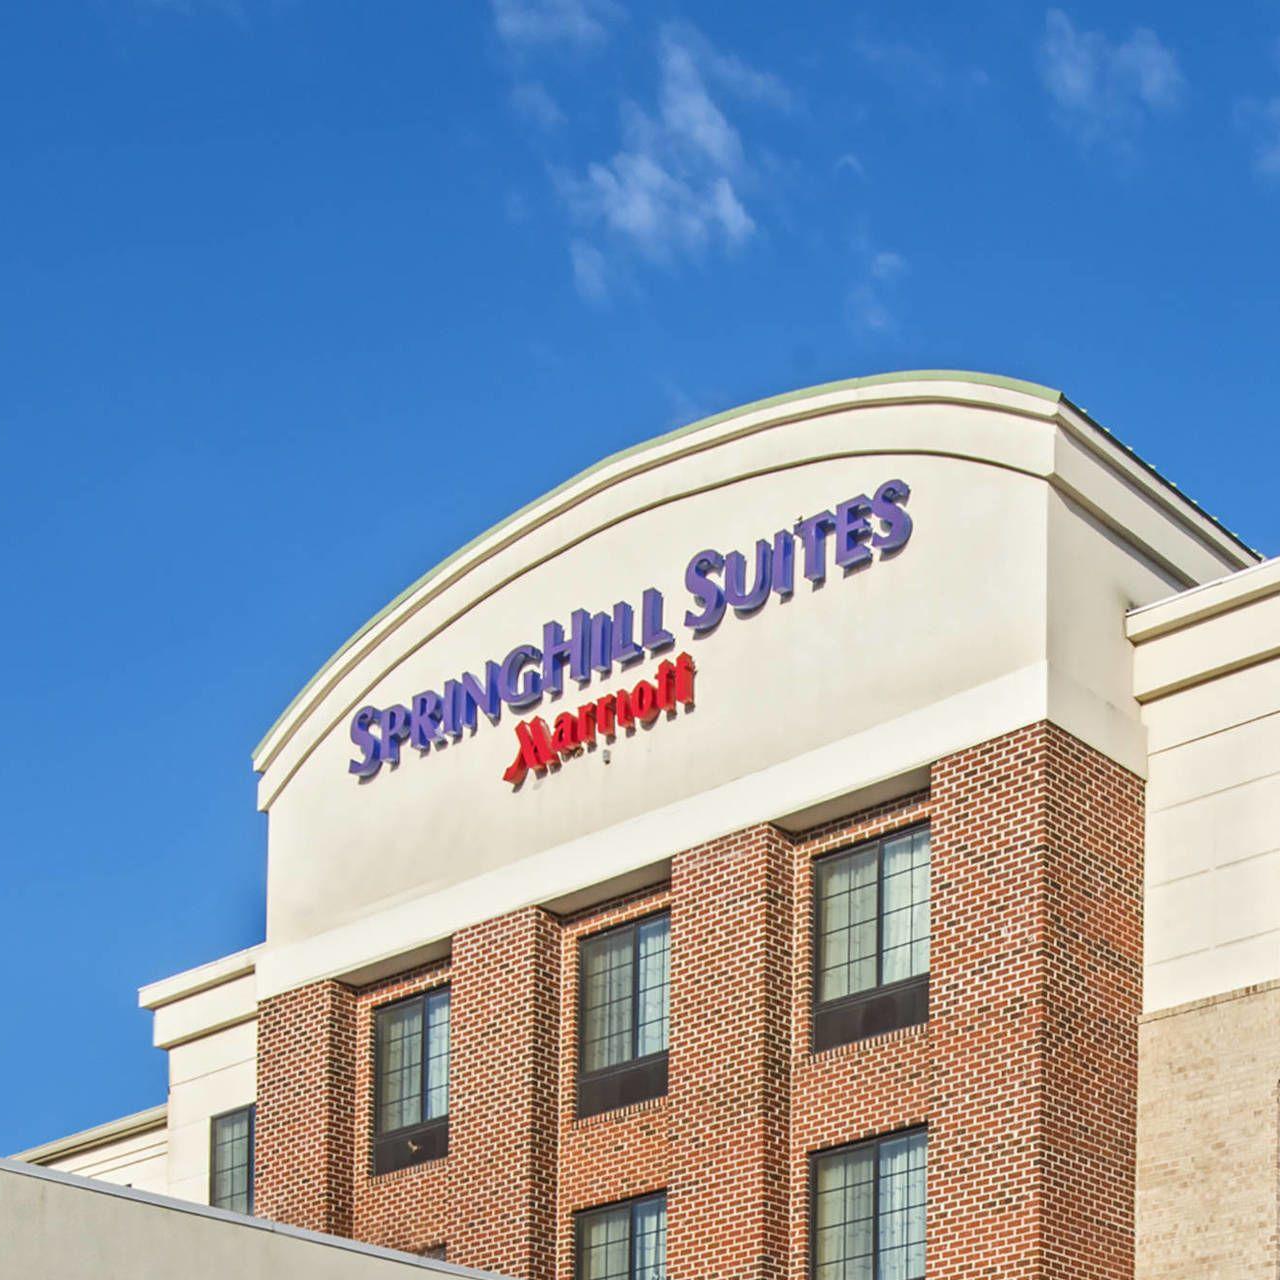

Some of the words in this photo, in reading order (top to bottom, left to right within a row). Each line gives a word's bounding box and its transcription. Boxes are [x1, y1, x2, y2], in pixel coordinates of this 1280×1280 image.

[349, 587, 675, 778] SPRINGHILL
[684, 478, 913, 634] SUITES
[503, 651, 696, 784] Marriott
